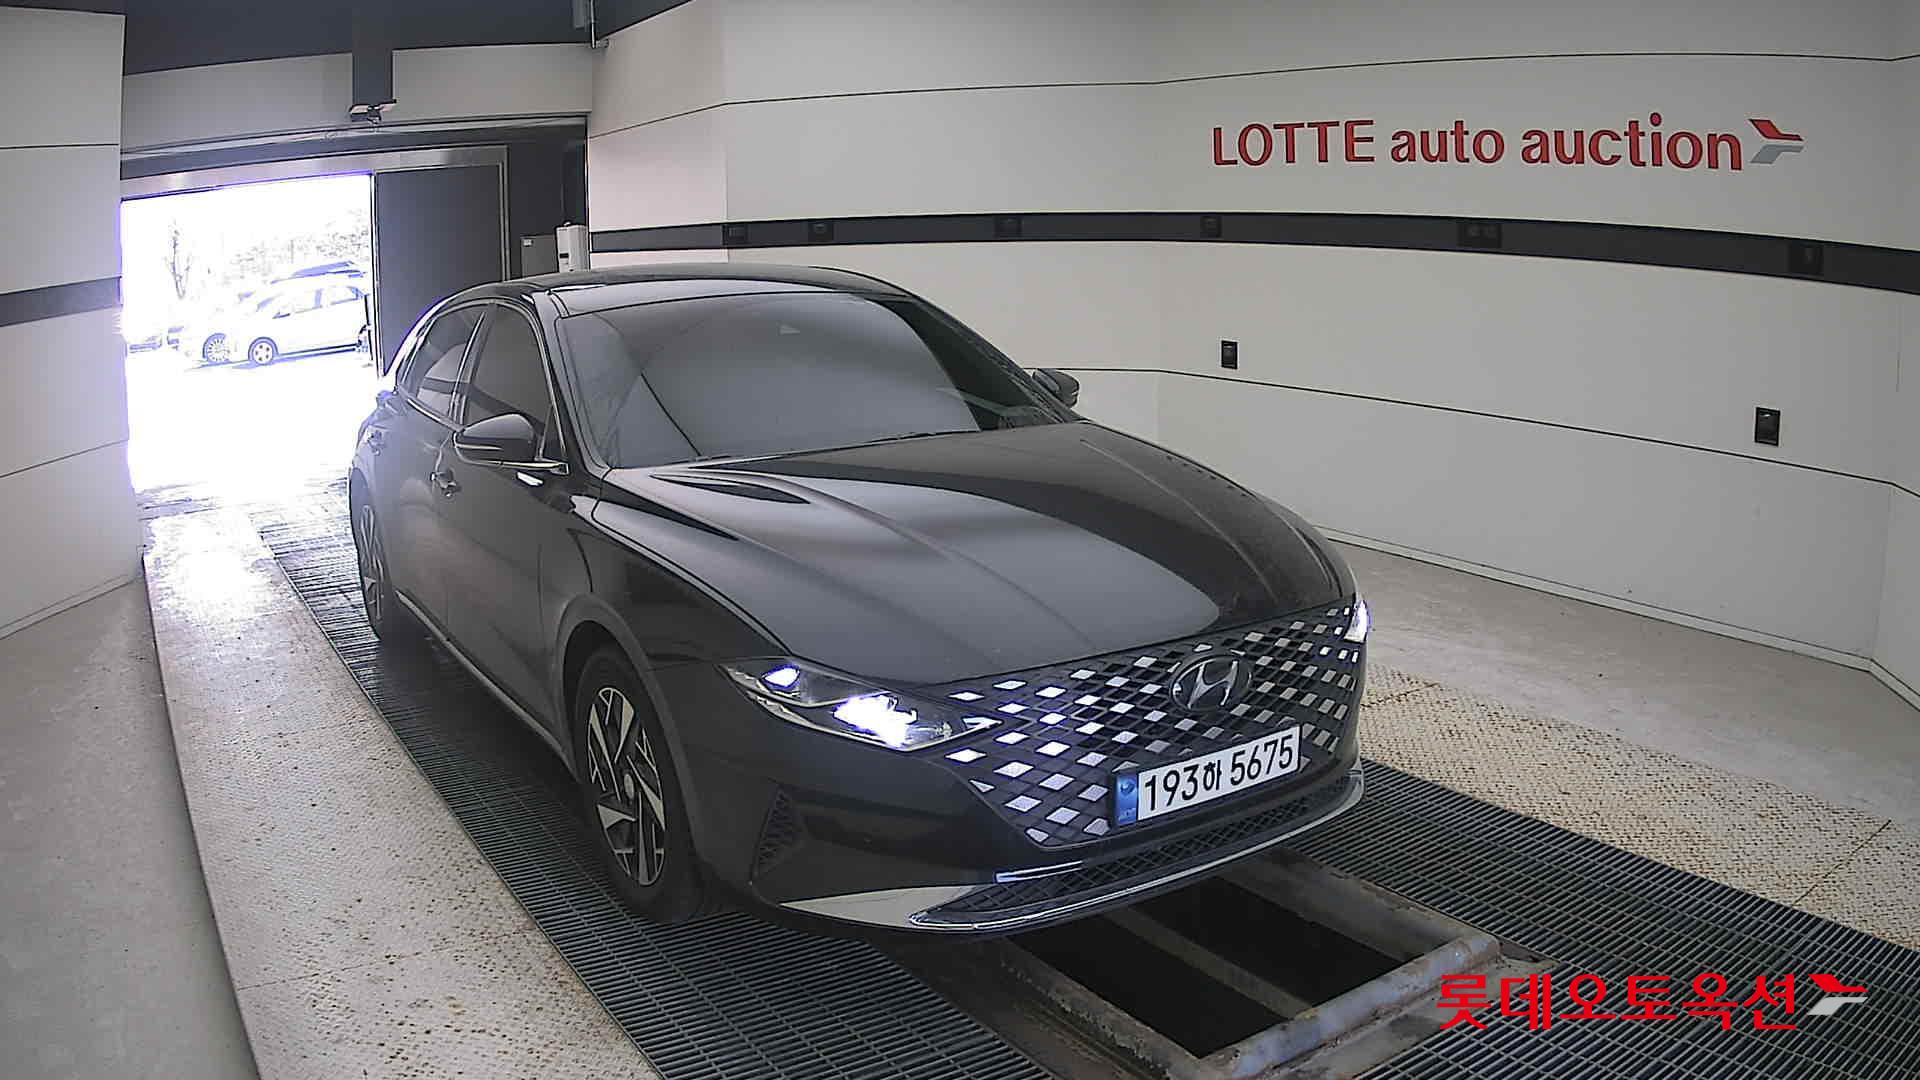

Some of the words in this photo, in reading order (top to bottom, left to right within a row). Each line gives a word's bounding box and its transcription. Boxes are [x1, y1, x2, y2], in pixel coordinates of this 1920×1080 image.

[1213, 119, 1375, 166] LOTTE
[1391, 119, 1501, 164] auto
[1521, 113, 1742, 171] auction
[1144, 759, 1222, 811] 193하
[1230, 734, 1293, 786] 5675
